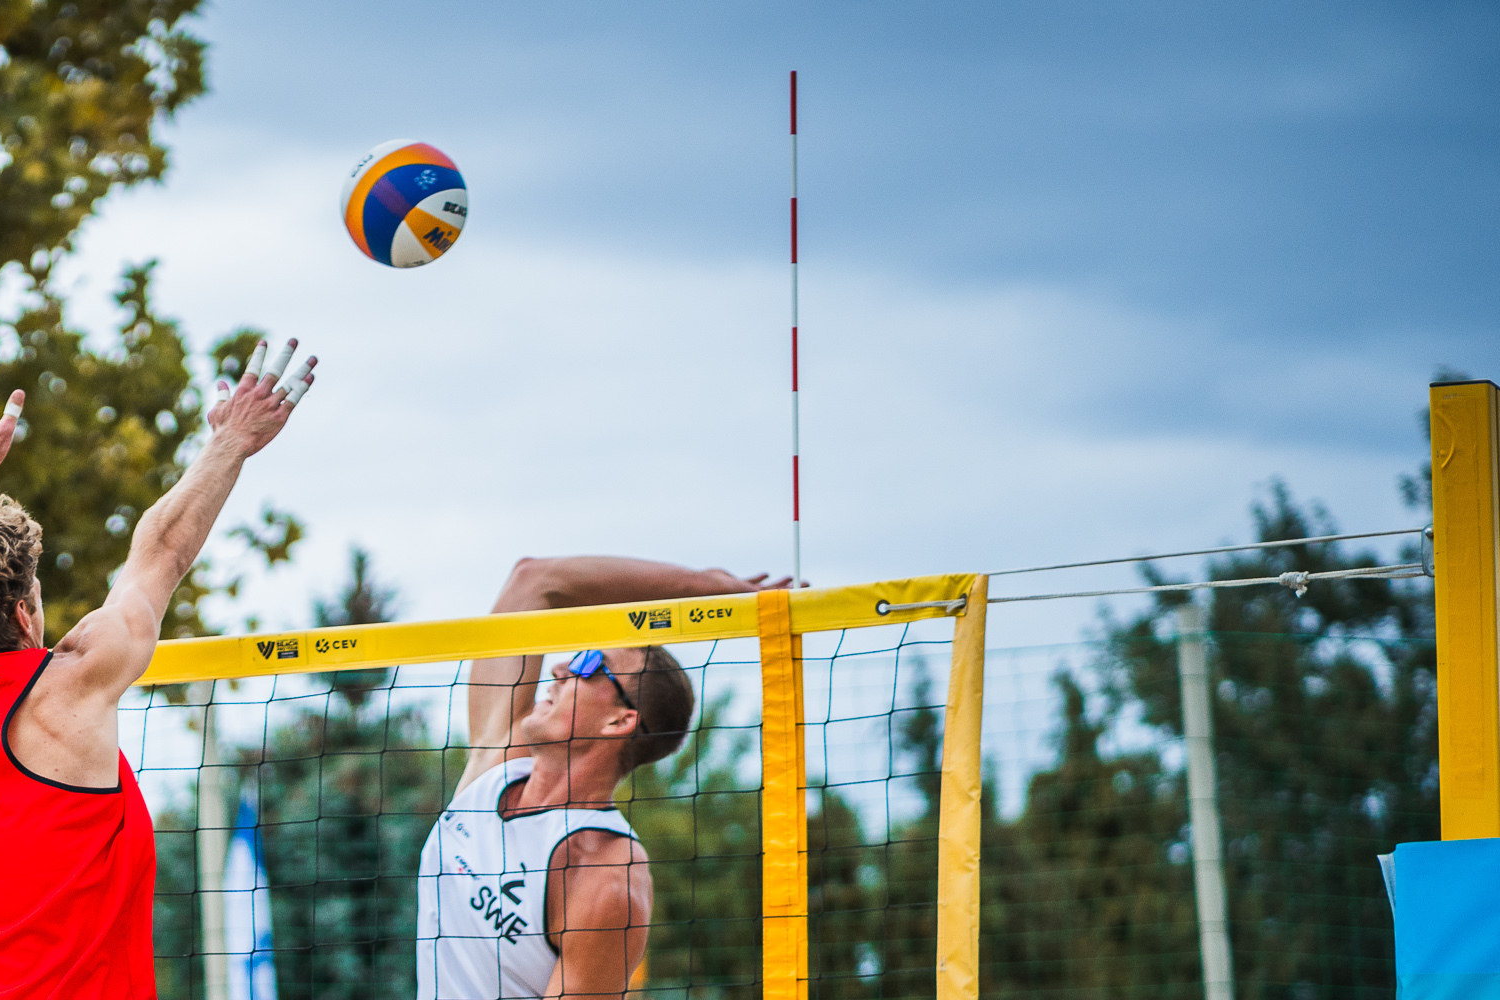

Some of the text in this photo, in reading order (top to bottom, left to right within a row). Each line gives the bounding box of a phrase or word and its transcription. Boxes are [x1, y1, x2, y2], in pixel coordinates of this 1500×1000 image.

[707, 608, 733, 619] CEV
[332, 639, 357, 650] CEV
[470, 886, 528, 945] SWE
